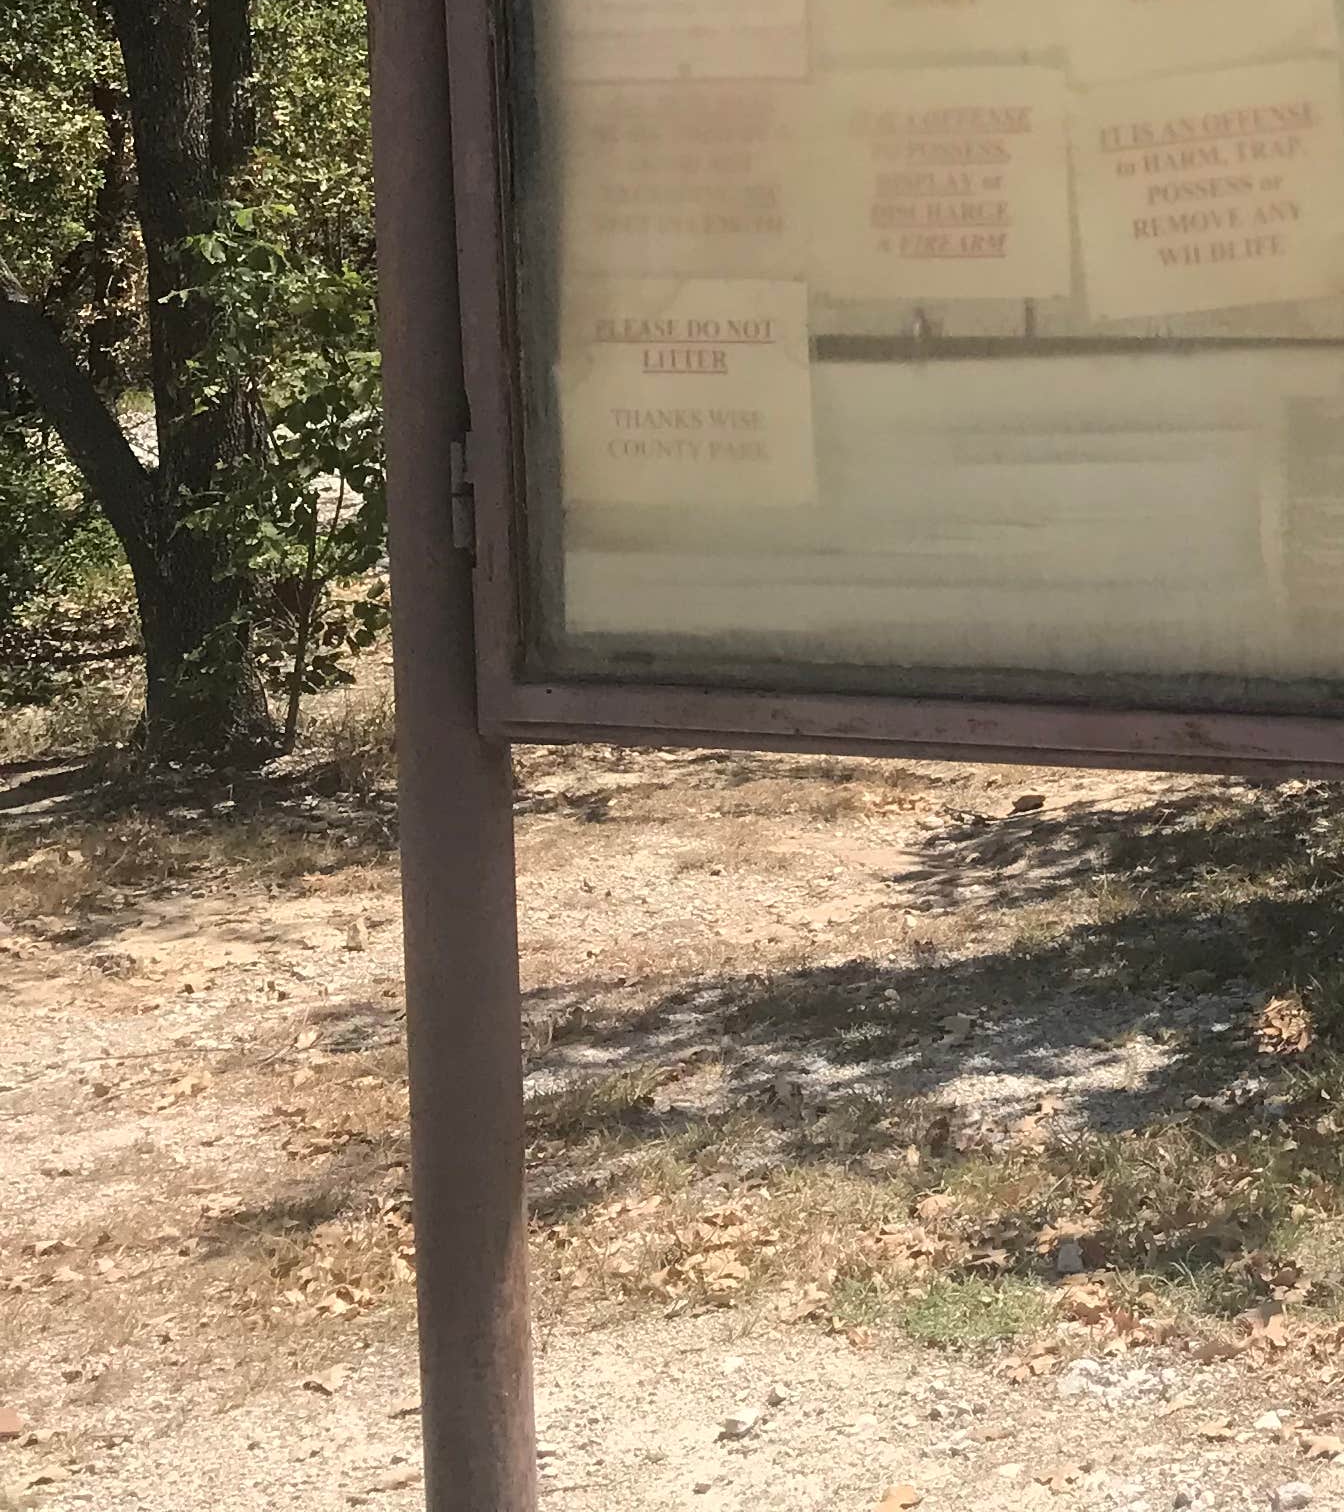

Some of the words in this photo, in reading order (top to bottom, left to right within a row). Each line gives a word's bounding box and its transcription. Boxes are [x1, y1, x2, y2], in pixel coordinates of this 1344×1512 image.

[1148, 177, 1254, 207] POSSESS
[1132, 206, 1243, 240] REMOVE
[1252, 199, 1302, 225] ANY
[1158, 235, 1286, 267] WILDLIFE
[594, 318, 678, 344] PLEASE
[686, 319, 721, 342] DO
[726, 319, 776, 344] NOT
[642, 348, 729, 374] LITTER
[610, 409, 703, 429] THANKS
[707, 409, 766, 430] WISE
[607, 439, 701, 461] COUNTY
